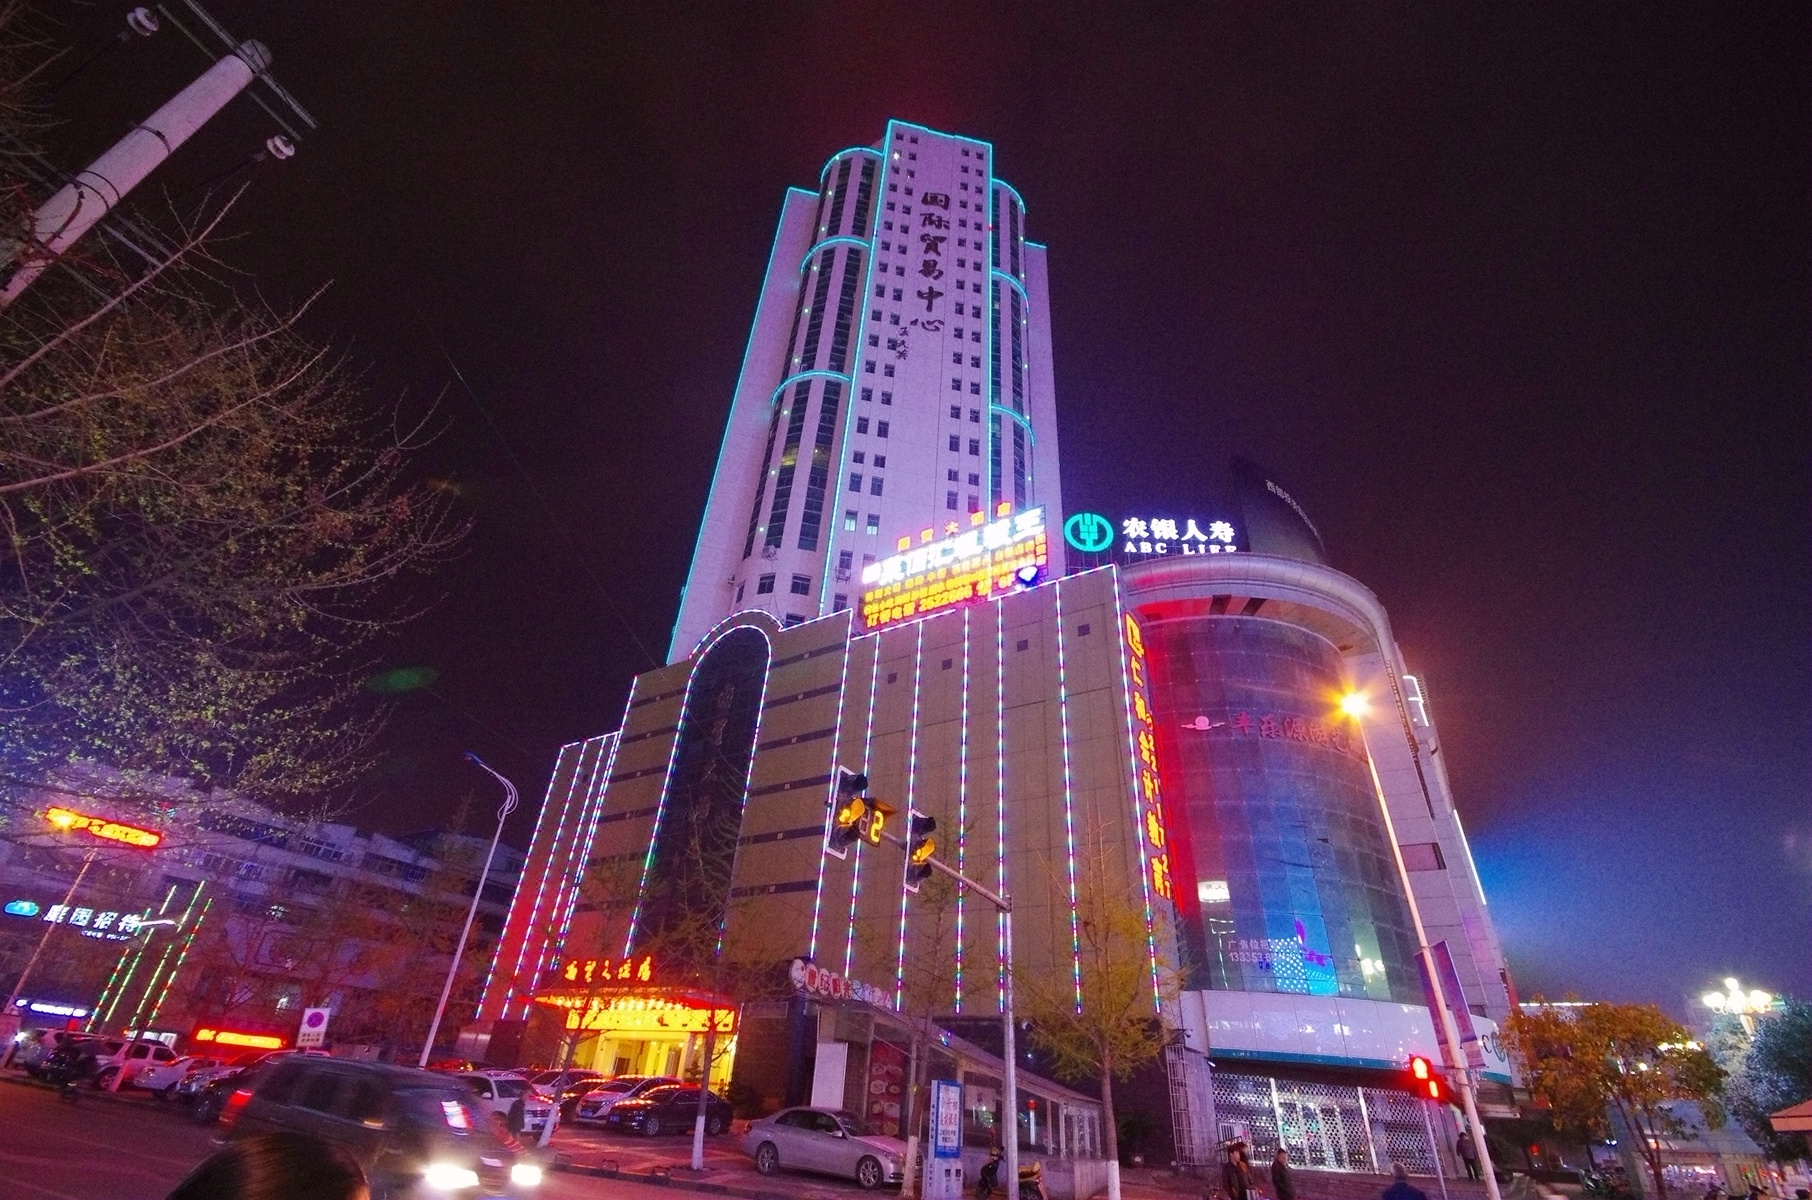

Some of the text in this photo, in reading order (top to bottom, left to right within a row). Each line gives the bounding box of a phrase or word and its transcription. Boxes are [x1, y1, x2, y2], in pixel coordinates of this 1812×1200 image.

[1122, 517, 1236, 543] 农银人寿
[1124, 541, 1168, 554] ABC
